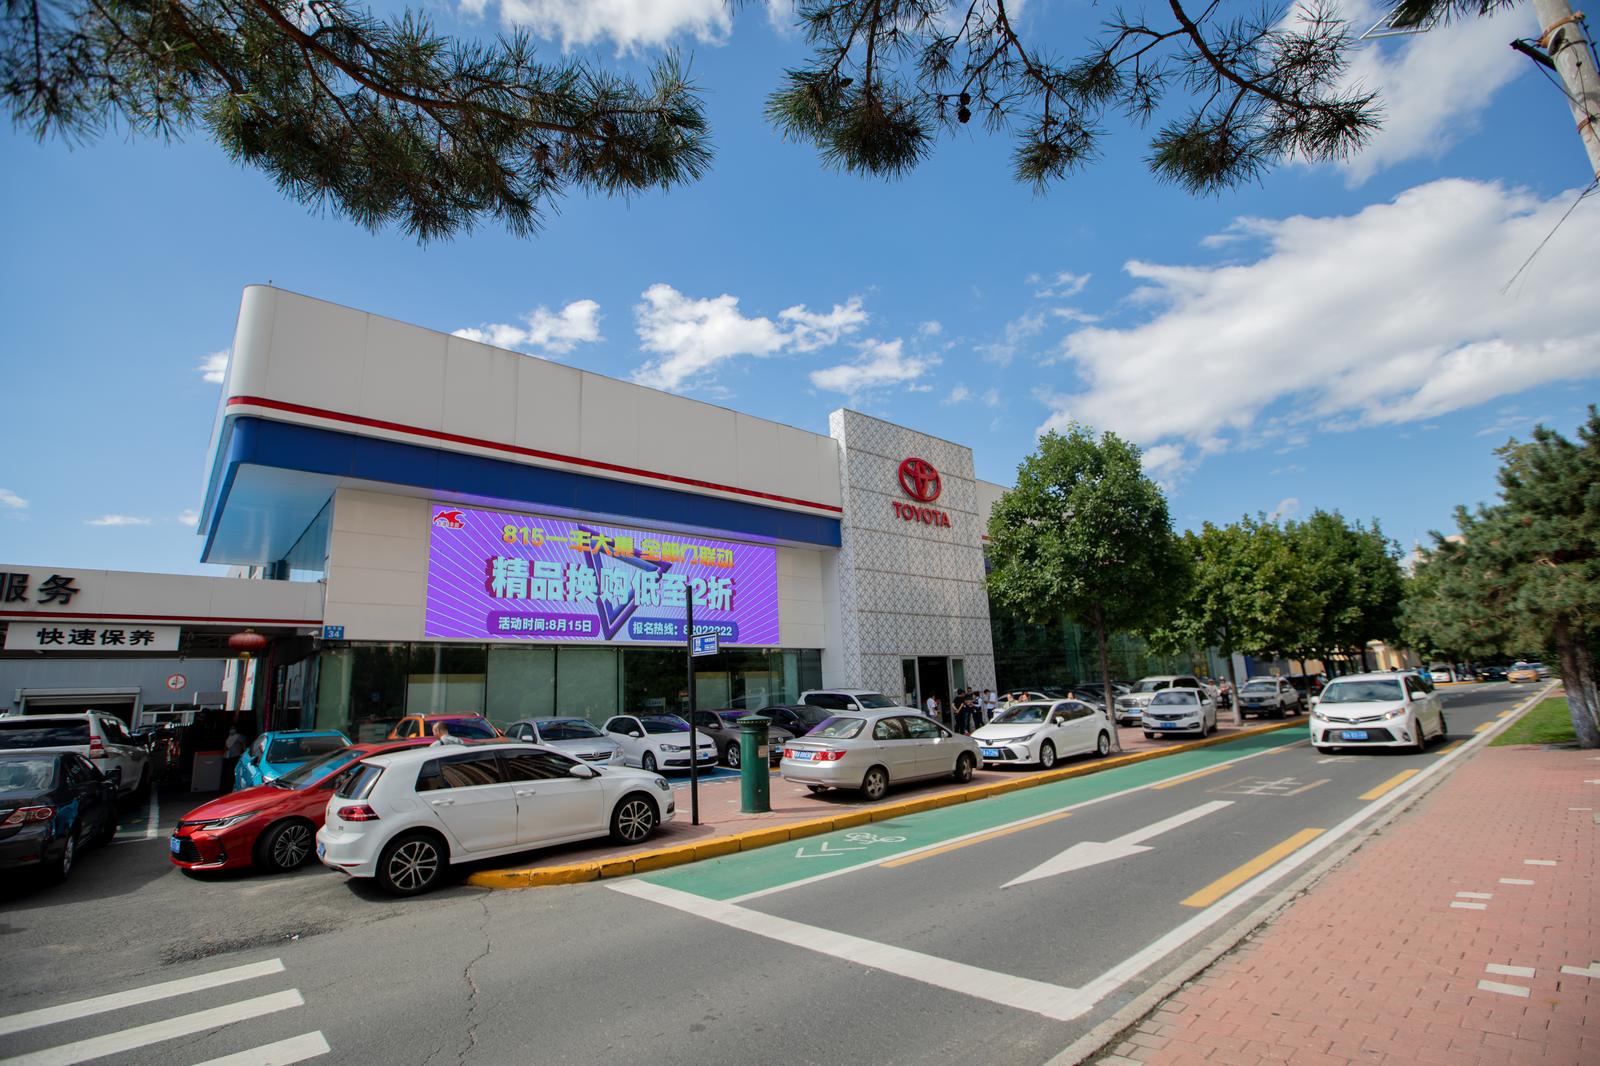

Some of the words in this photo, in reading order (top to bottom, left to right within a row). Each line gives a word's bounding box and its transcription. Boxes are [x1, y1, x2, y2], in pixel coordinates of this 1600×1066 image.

[892, 501, 952, 528] TOYOTA
[0, 573, 80, 605] 服务
[491, 556, 733, 611] 精品换购低至2折
[36, 628, 155, 646] 快速保养
[498, 616, 592, 632] 活动时间:8月15日
